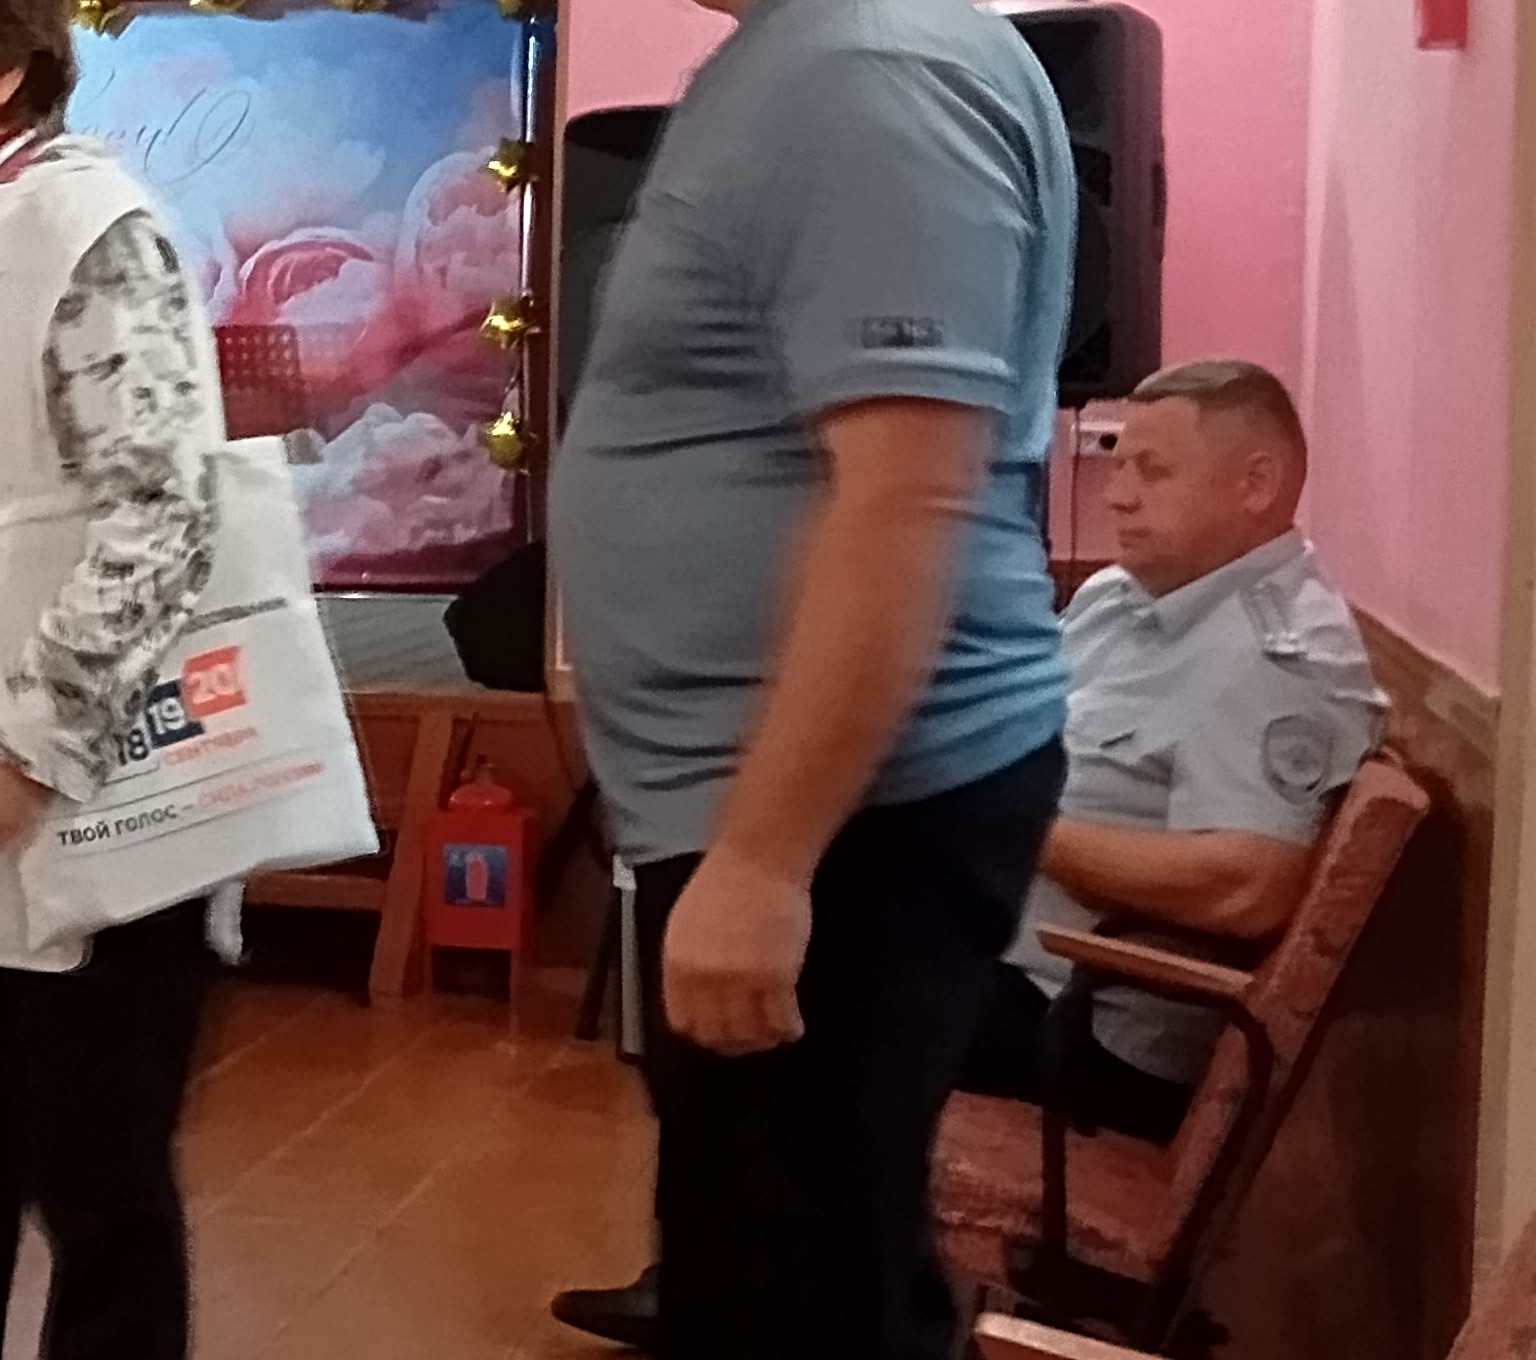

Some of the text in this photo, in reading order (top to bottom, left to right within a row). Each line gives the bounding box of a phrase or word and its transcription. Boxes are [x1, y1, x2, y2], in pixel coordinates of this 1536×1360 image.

[148, 696, 189, 735] 19
[185, 662, 234, 706] 20
[56, 821, 112, 848] ТВОЙ
[115, 803, 179, 837] ГОЛОС
